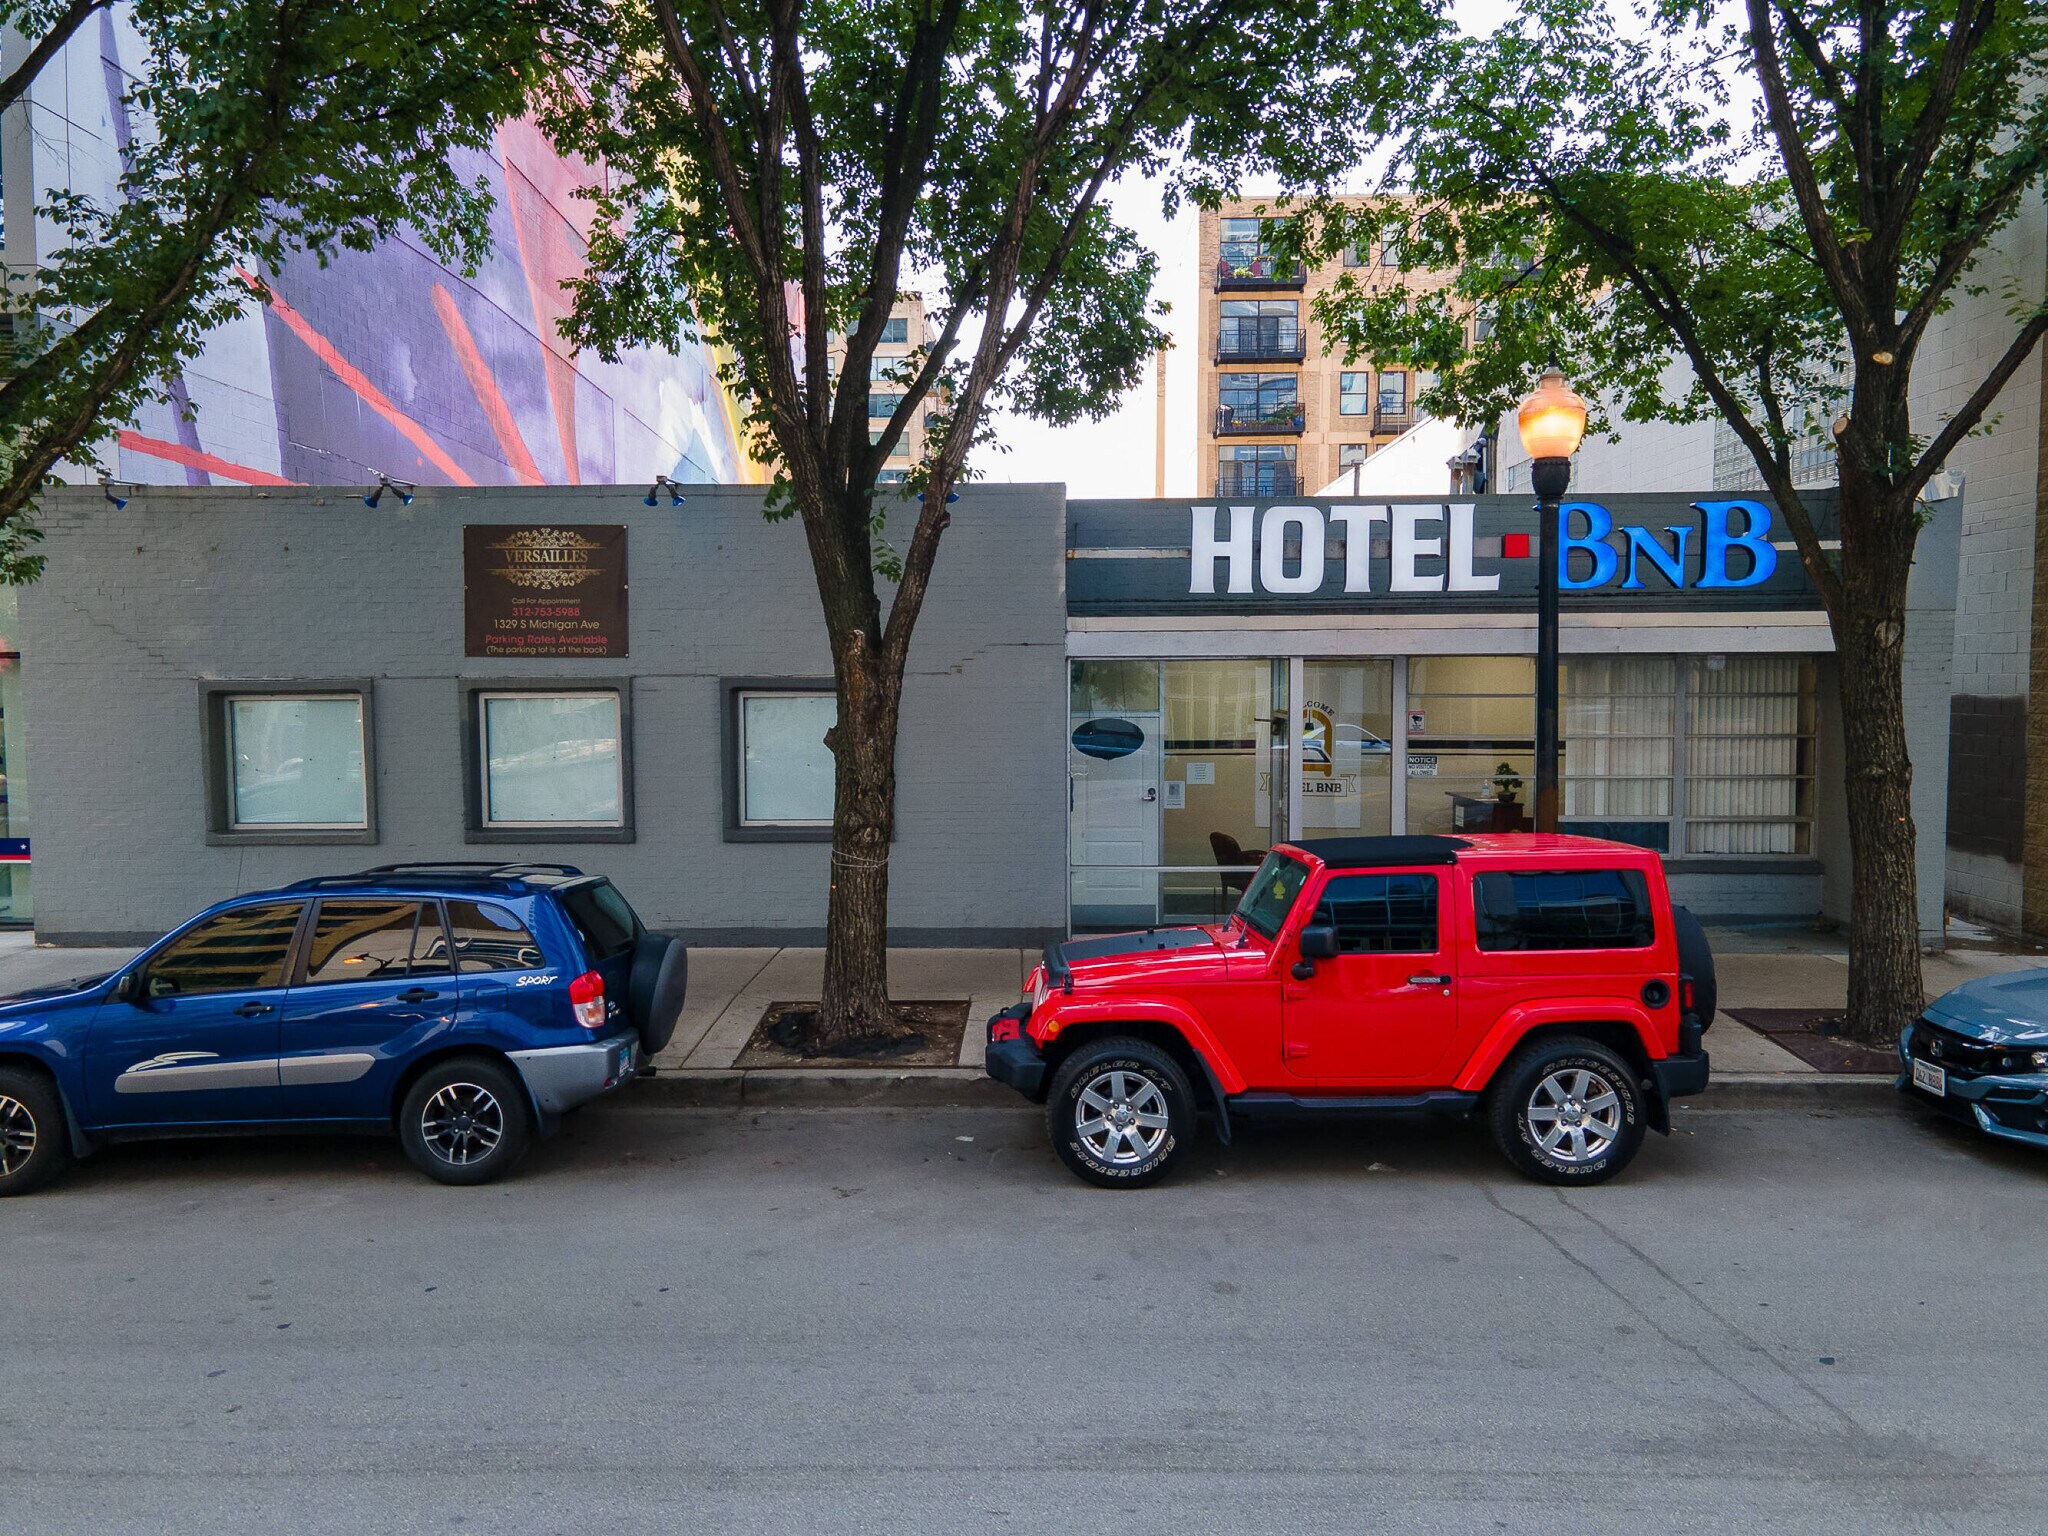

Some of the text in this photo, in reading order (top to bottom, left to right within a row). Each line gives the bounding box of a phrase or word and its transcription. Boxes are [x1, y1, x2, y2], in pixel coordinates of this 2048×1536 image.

[1189, 503, 1501, 594] HOTEL
[504, 550, 588, 562] VERSAILLES
[512, 607, 580, 616] 312-753-5988
[494, 619, 600, 631] 1329 S Michigan Ave
[485, 635, 608, 646] Parking Rates Available
[486, 646, 503, 654] (The
[506, 646, 536, 654] parking
[583, 646, 607, 654] back)
[1303, 701, 1335, 717] COME
[1316, 782, 1342, 793] BNB
[516, 976, 558, 986] SPORT
